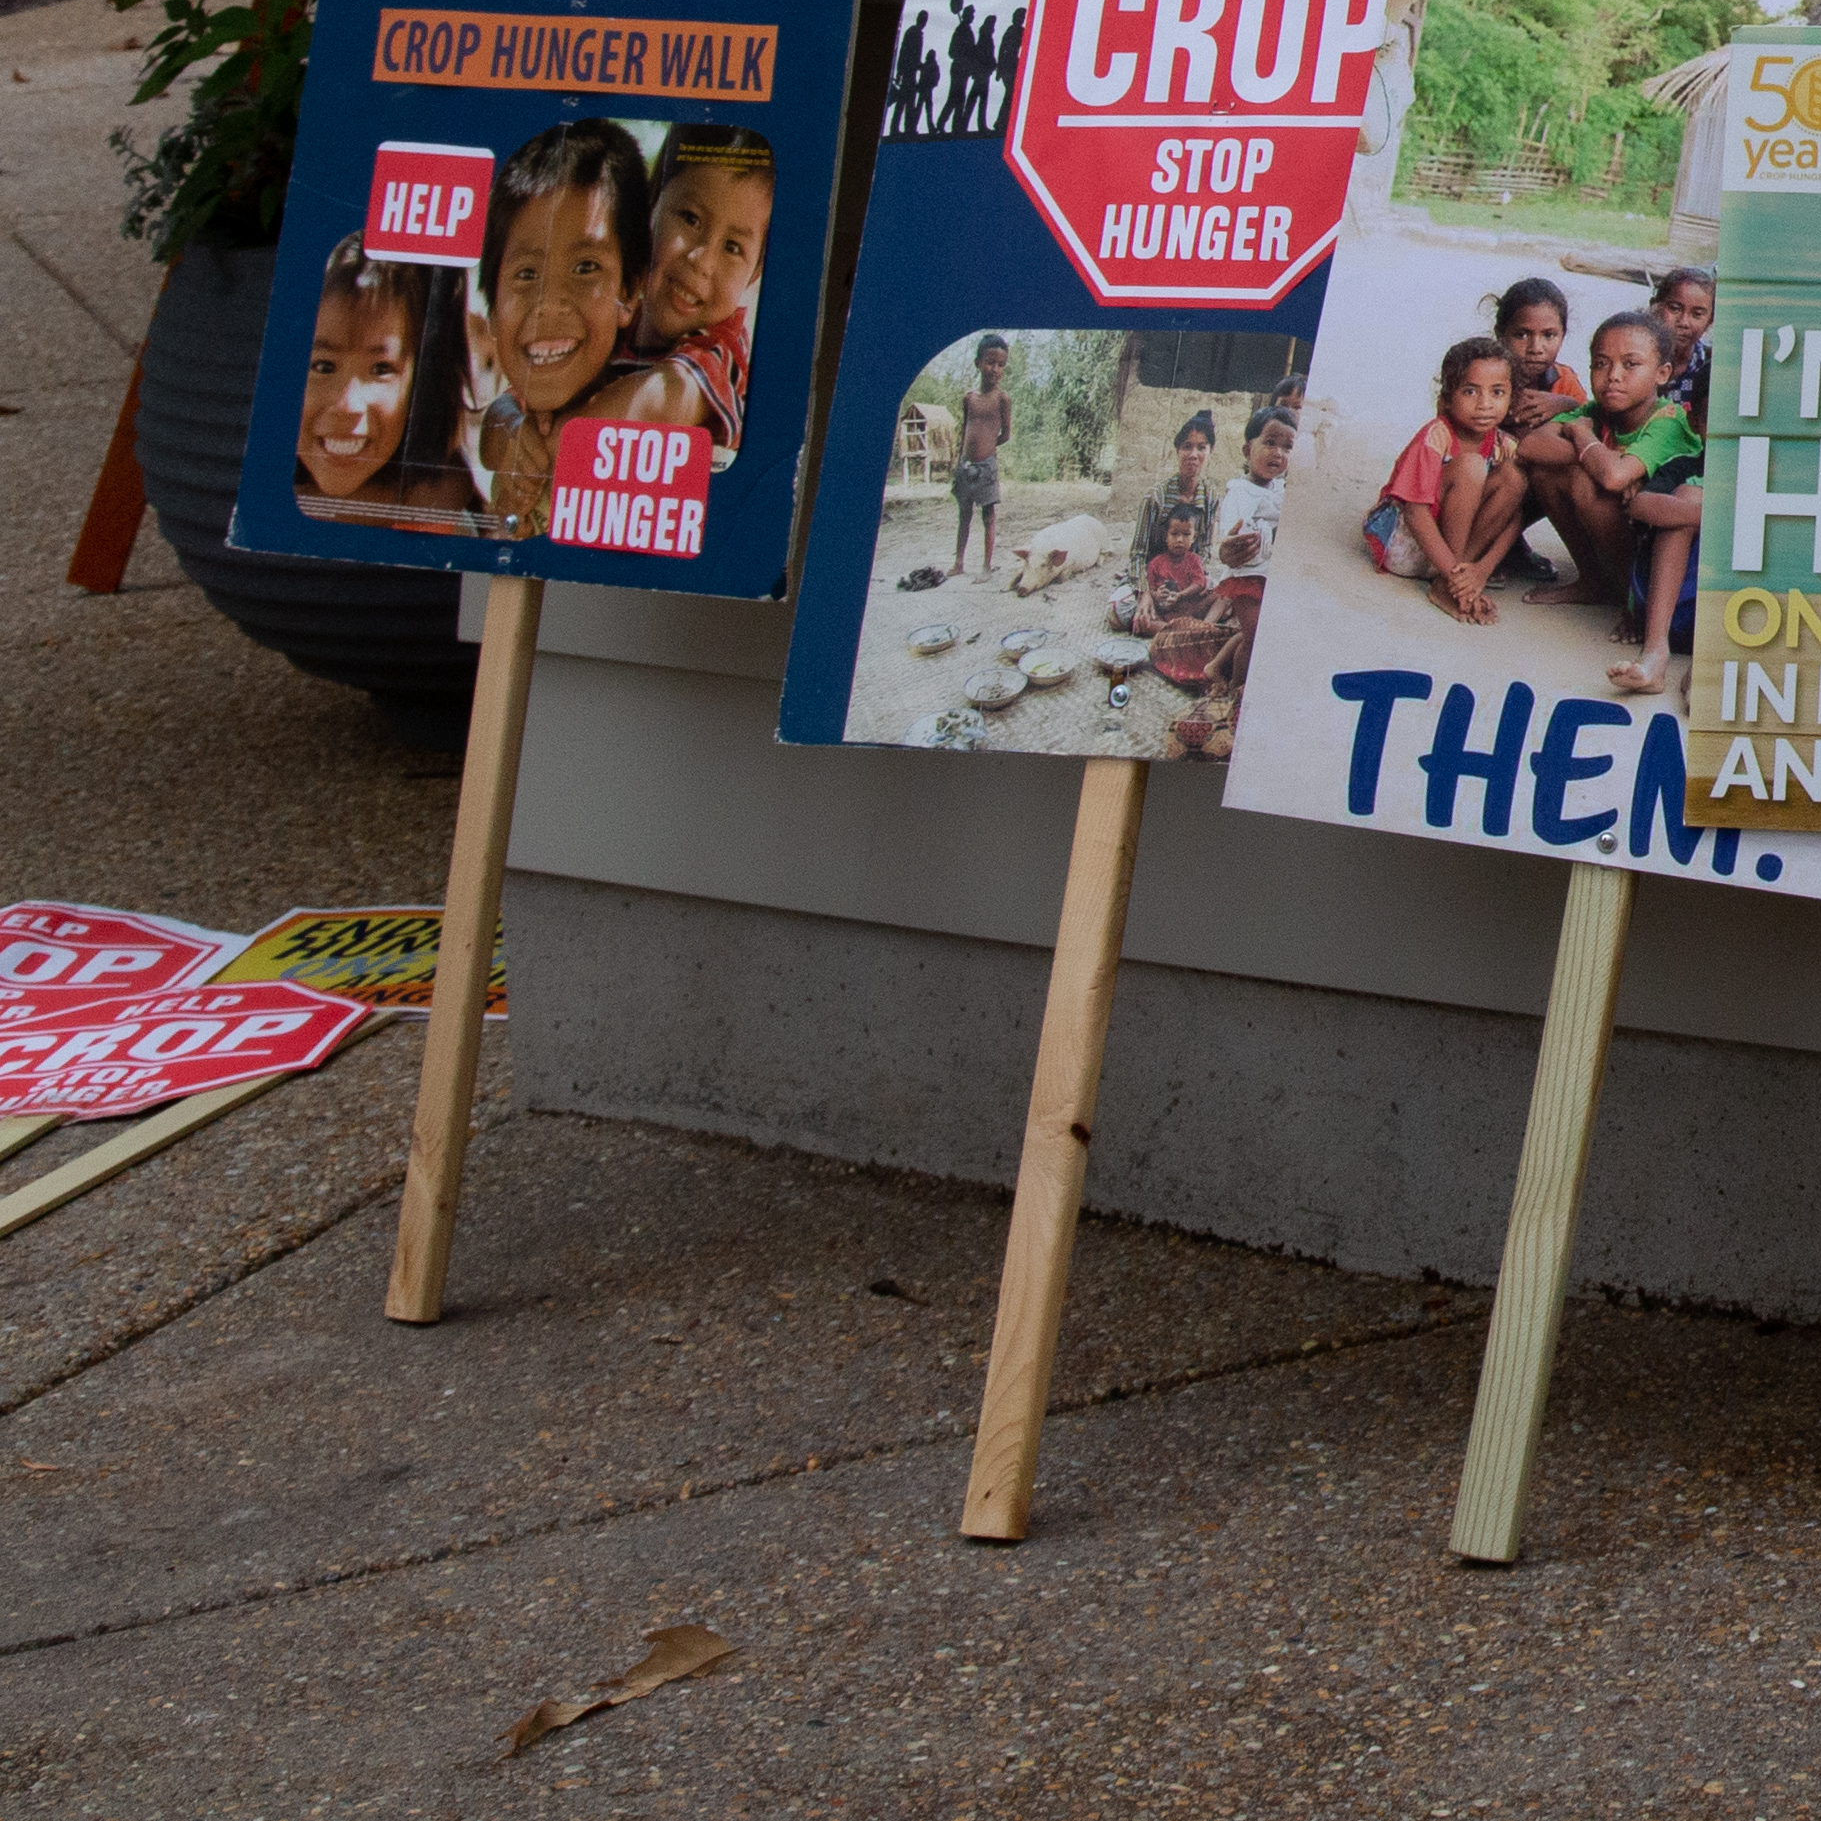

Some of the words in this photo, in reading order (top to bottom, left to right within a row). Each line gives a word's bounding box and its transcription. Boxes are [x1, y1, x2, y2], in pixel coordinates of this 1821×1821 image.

[381, 19, 482, 76] CROP
[490, 24, 649, 87] HUNGER
[659, 32, 770, 92] WALK
[1150, 137, 1275, 195] STOP
[1759, 171, 1787, 181] CROP
[379, 181, 475, 238] HELP
[1099, 203, 1292, 263] HUNGER
[593, 426, 691, 485] STOP
[550, 486, 704, 554] HUNGER
[1721, 660, 1798, 724] IN
[1331, 668, 1784, 883] THEM.
[114, 994, 244, 1022] HELP
[27, 1065, 164, 1094] STOP
